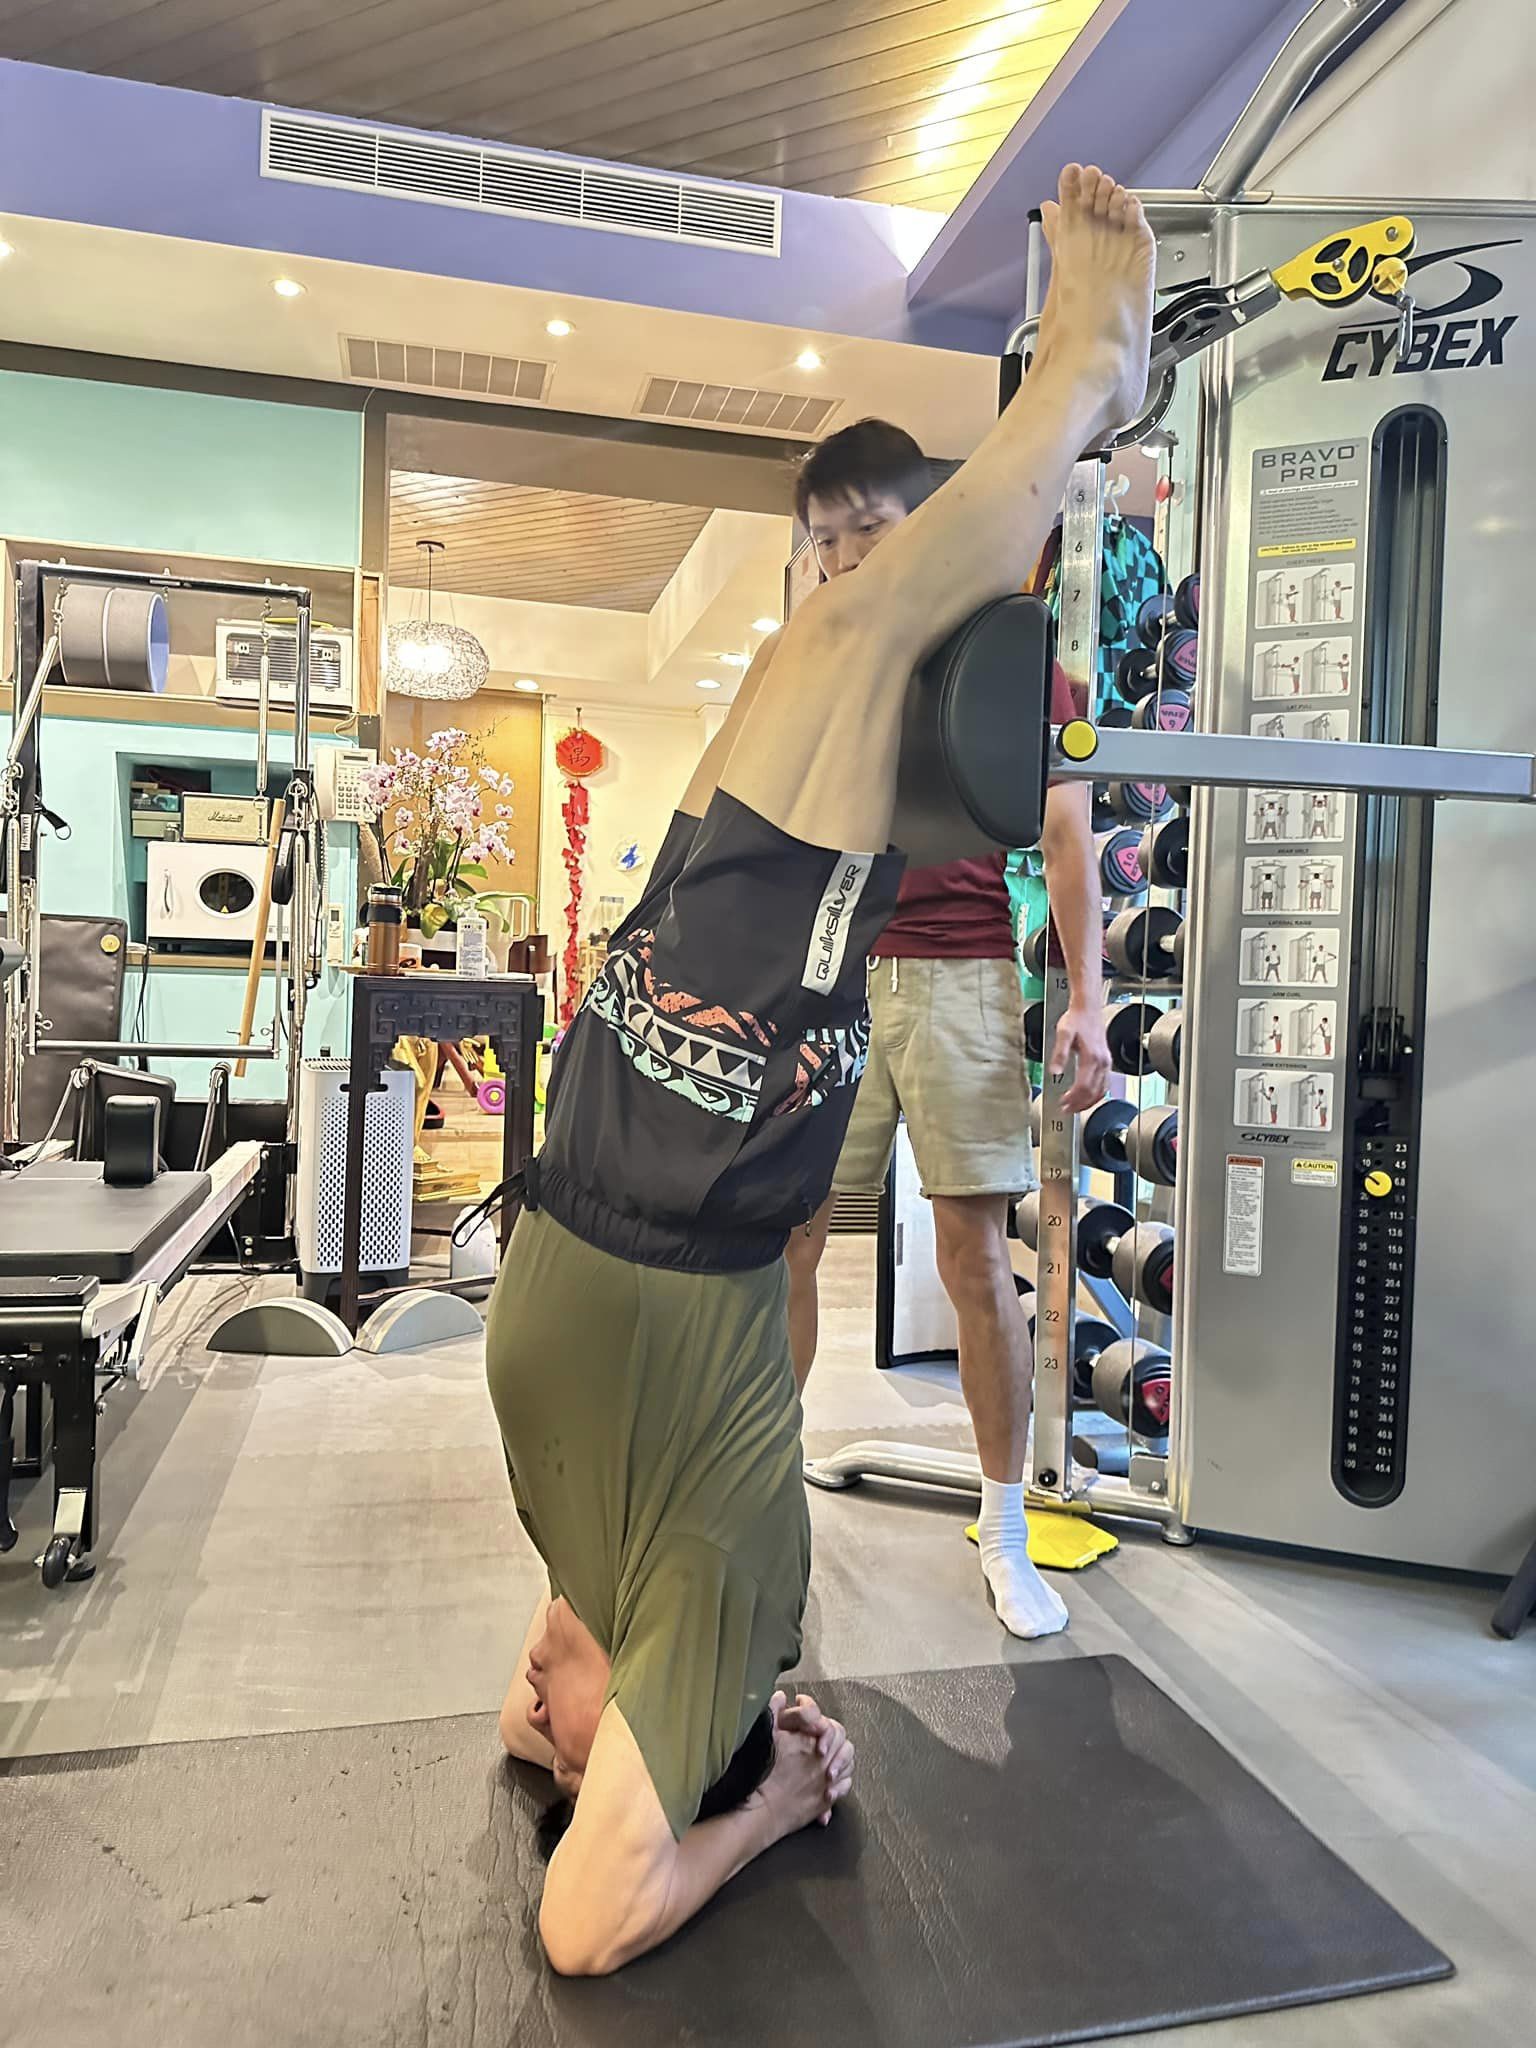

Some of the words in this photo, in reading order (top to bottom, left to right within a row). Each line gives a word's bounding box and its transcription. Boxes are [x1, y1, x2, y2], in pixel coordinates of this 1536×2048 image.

[1321, 316, 1519, 381] CYBEX
[1262, 445, 1354, 469] BRAVO
[1281, 464, 1337, 482] PRO
[1076, 490, 1085, 503] 5
[1075, 540, 1082, 553] 6
[1072, 589, 1081, 602] 7
[1070, 640, 1079, 652] 8
[1055, 977, 1068, 990] 15
[1052, 1073, 1064, 1085] 17
[1051, 1119, 1063, 1132] 18
[1255, 1132, 1290, 1145] CYBEX
[1303, 1161, 1334, 1171] CAUTION
[1362, 1158, 1371, 1168] 10
[1050, 1167, 1062, 1180] 19
[1359, 1208, 1369, 1218] 25
[1047, 1214, 1062, 1227] 20
[1047, 1263, 1061, 1275] 21
[1045, 1310, 1060, 1322] 22
[1044, 1357, 1058, 1370] 23
